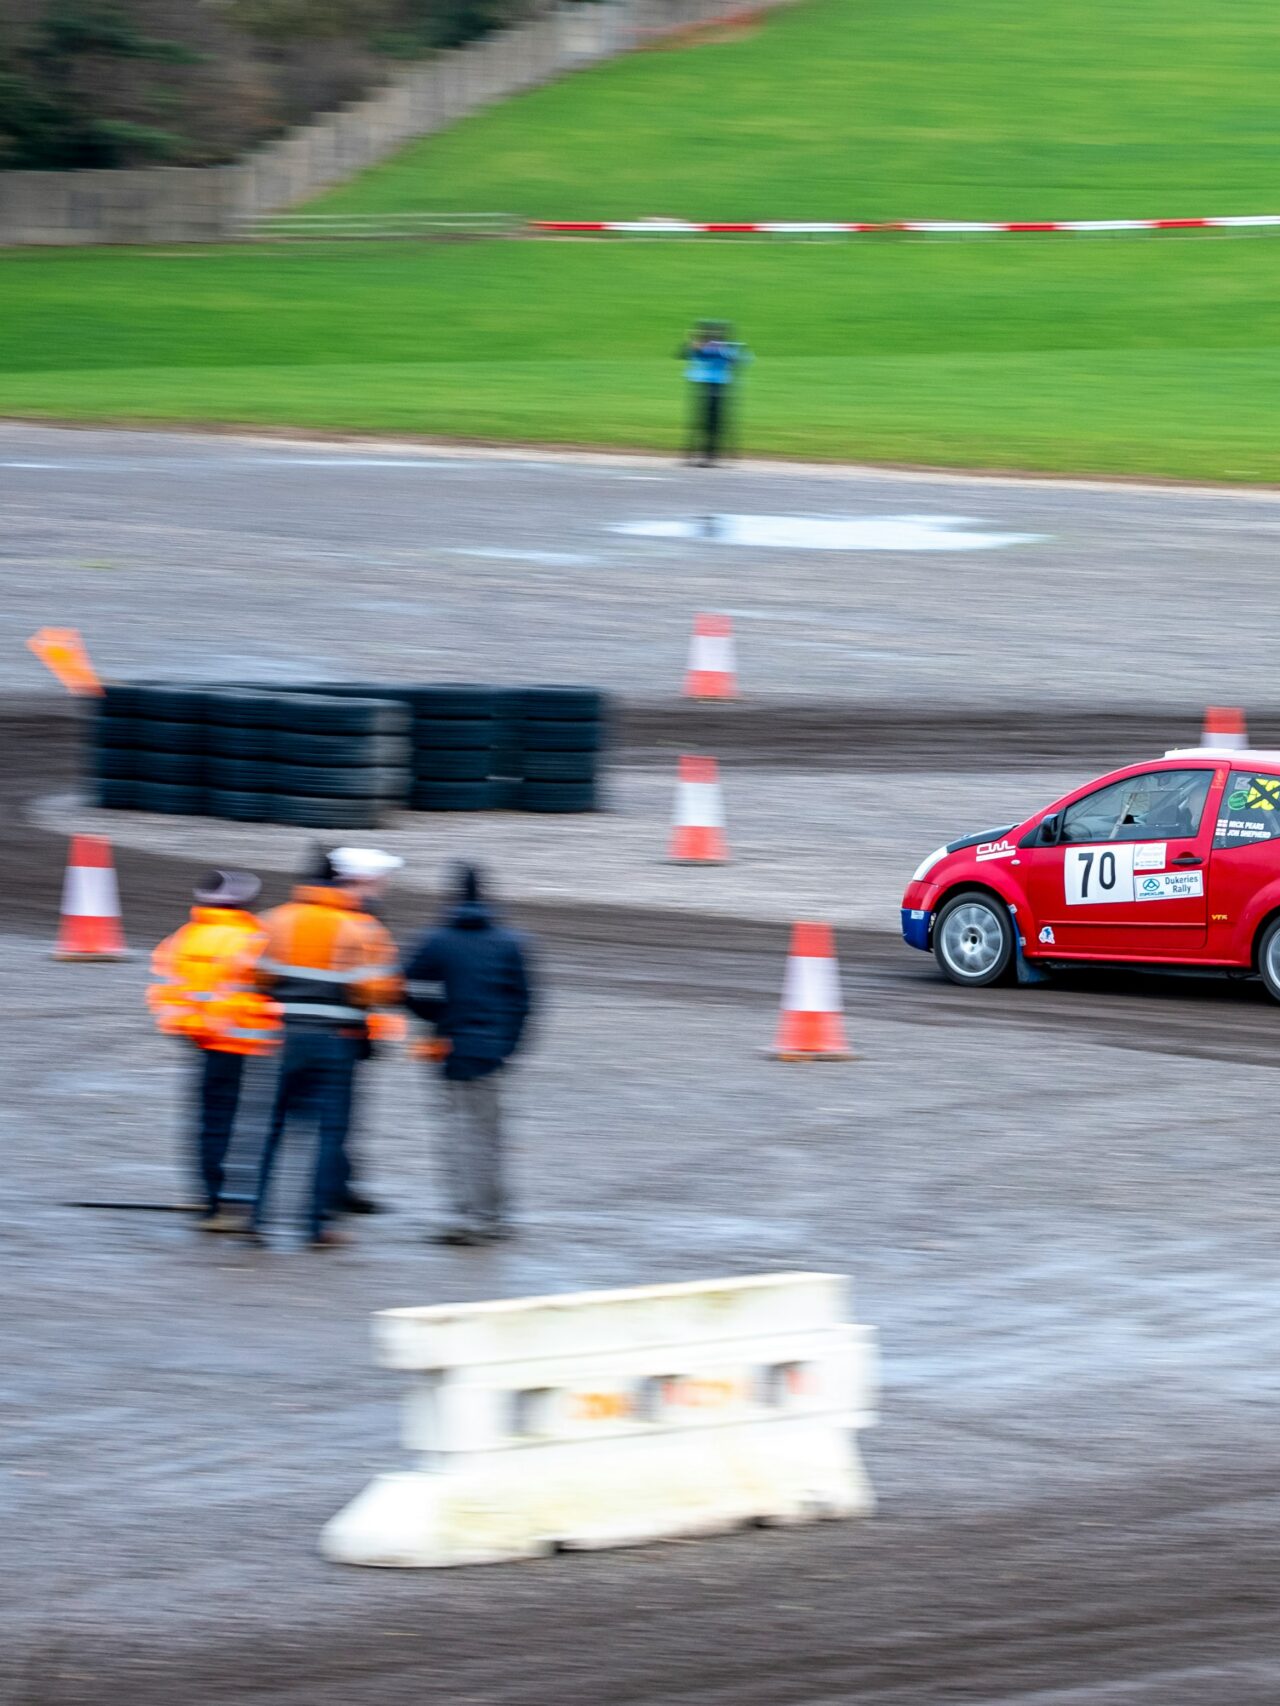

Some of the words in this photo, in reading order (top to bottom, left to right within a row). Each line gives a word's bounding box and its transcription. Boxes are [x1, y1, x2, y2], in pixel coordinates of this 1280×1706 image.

[1078, 852, 1116, 898] 70
[1165, 875, 1199, 885] Dukeries
[1172, 884, 1191, 893] Rally
